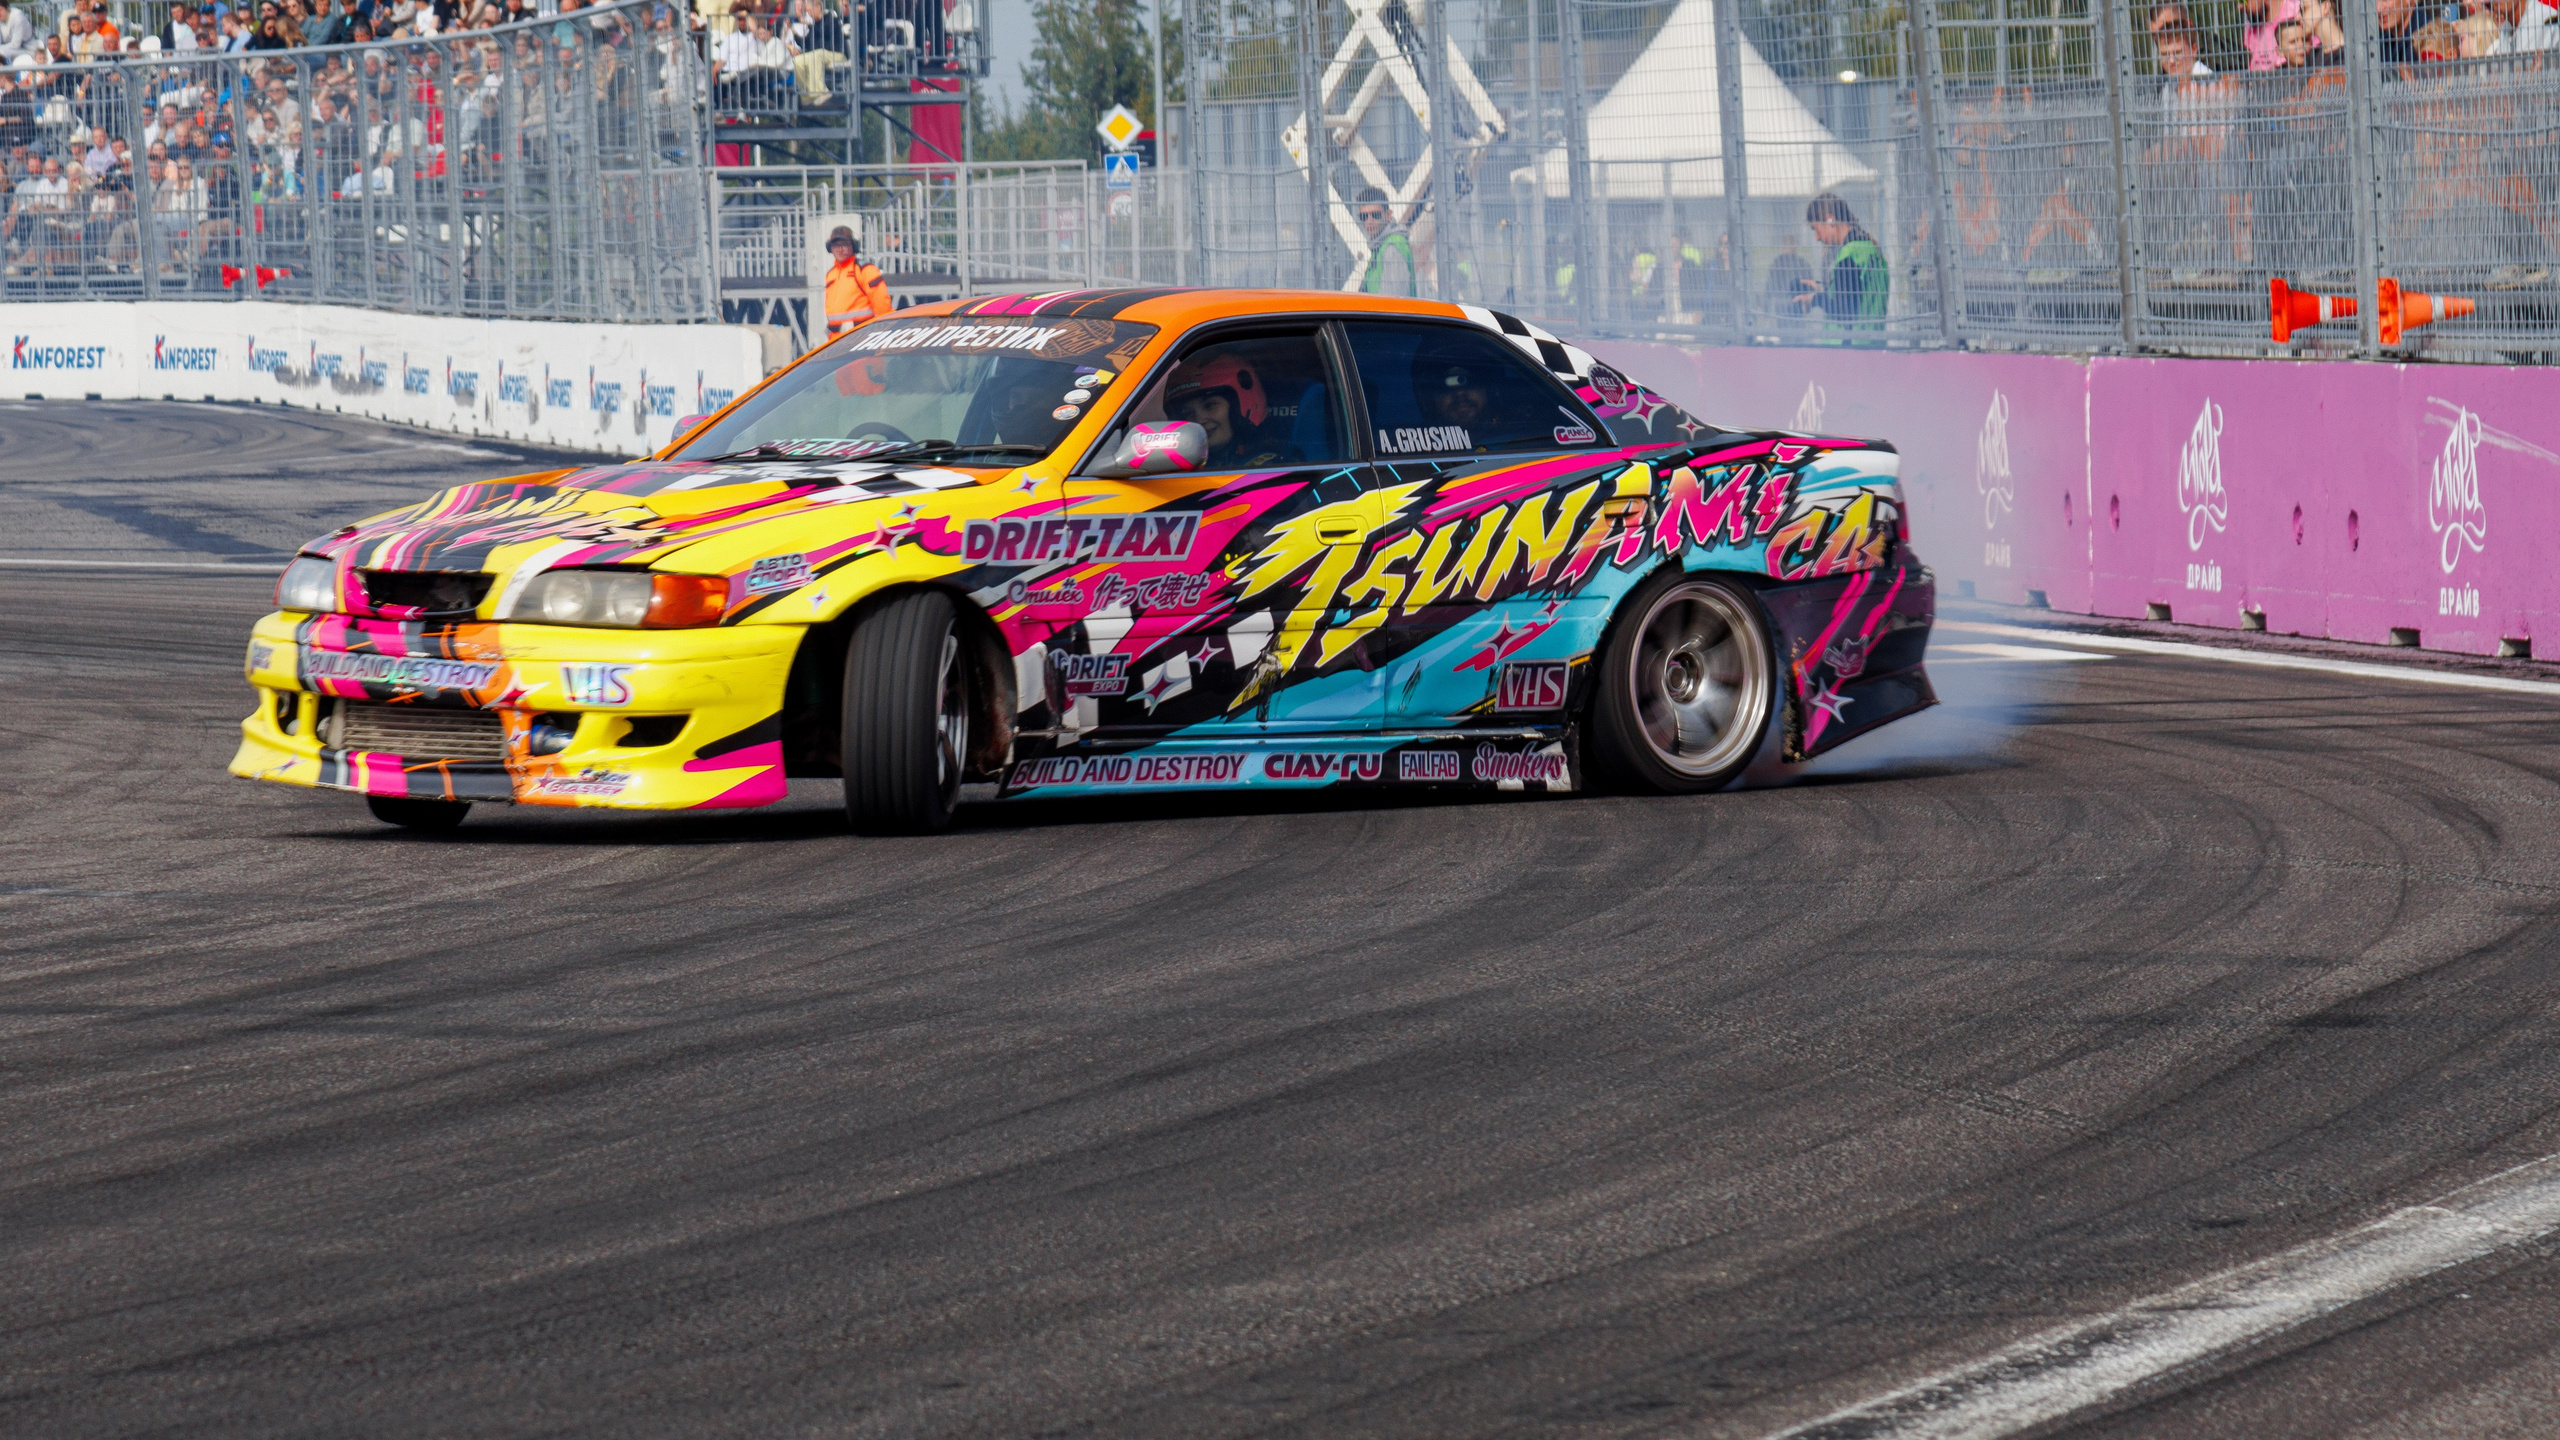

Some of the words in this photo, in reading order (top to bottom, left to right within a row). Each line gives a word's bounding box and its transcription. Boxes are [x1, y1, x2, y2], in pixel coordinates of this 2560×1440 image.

[13, 335, 106, 369] KINFOREST
[154, 334, 217, 370] KINFOREST
[248, 334, 288, 372] KINFOREST
[850, 326, 939, 352] ТАКСИ
[934, 325, 1067, 351] ПРЕСТИЖ
[1596, 377, 1618, 387] HELL
[1145, 433, 1178, 443] DRIFT
[1378, 426, 1472, 454] A.GRUSHIN
[749, 565, 808, 587] СПОРТ
[754, 553, 803, 572] АВТО
[2186, 559, 2222, 593] ДРАЙВ
[1091, 573, 1212, 611] 作って壊せ
[2439, 581, 2480, 618] ДРАЙВ
[308, 653, 353, 676] BUILD
[352, 656, 393, 679] AND
[393, 659, 496, 687] DESTROY
[1068, 655, 1130, 679] DRIFT
[565, 664, 634, 705] VHS
[1092, 681, 1121, 693] EXPO
[1506, 666, 1564, 706] VHS
[1012, 756, 1079, 785] BUILD
[1081, 756, 1134, 783] AND
[1135, 753, 1248, 782] DESTROY
[1473, 741, 1567, 781] Smokers
